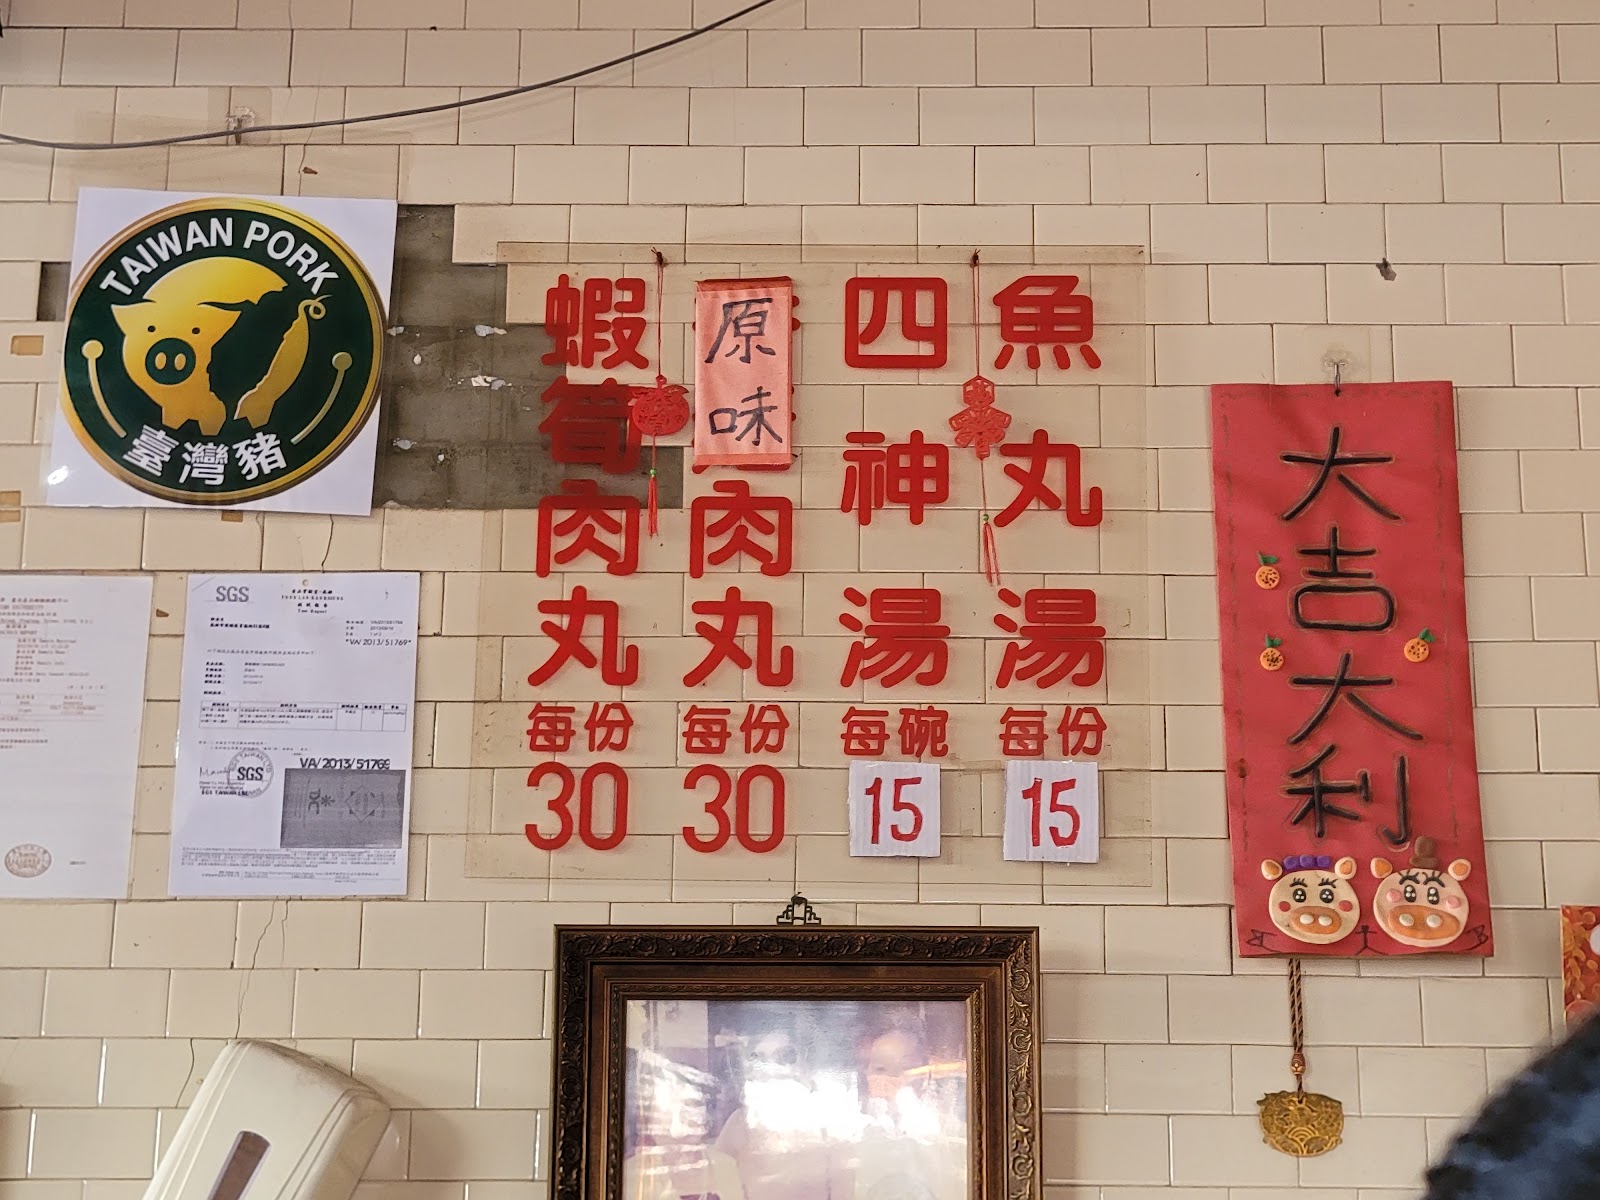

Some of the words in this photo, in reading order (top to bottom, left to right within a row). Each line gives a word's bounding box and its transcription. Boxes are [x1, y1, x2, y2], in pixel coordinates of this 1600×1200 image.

[100, 216, 233, 297] TAIWAN
[243, 220, 339, 295] PORK
[704, 297, 783, 447] 原味
[122, 423, 287, 486] 臺灣豬
[840, 276, 950, 688] 四神湯
[993, 275, 1106, 688] 魚丸湯
[215, 585, 250, 602] SGS
[1280, 426, 1424, 847] 大吉大利
[526, 702, 633, 754] 每份
[683, 704, 790, 754] 每份
[841, 706, 948, 757] 每碗
[999, 706, 1107, 757] 每份
[237, 766, 264, 781] SGS
[525, 761, 629, 851] 30
[682, 763, 785, 853] 30
[864, 777, 923, 845] 15
[1021, 777, 1081, 848] 15
